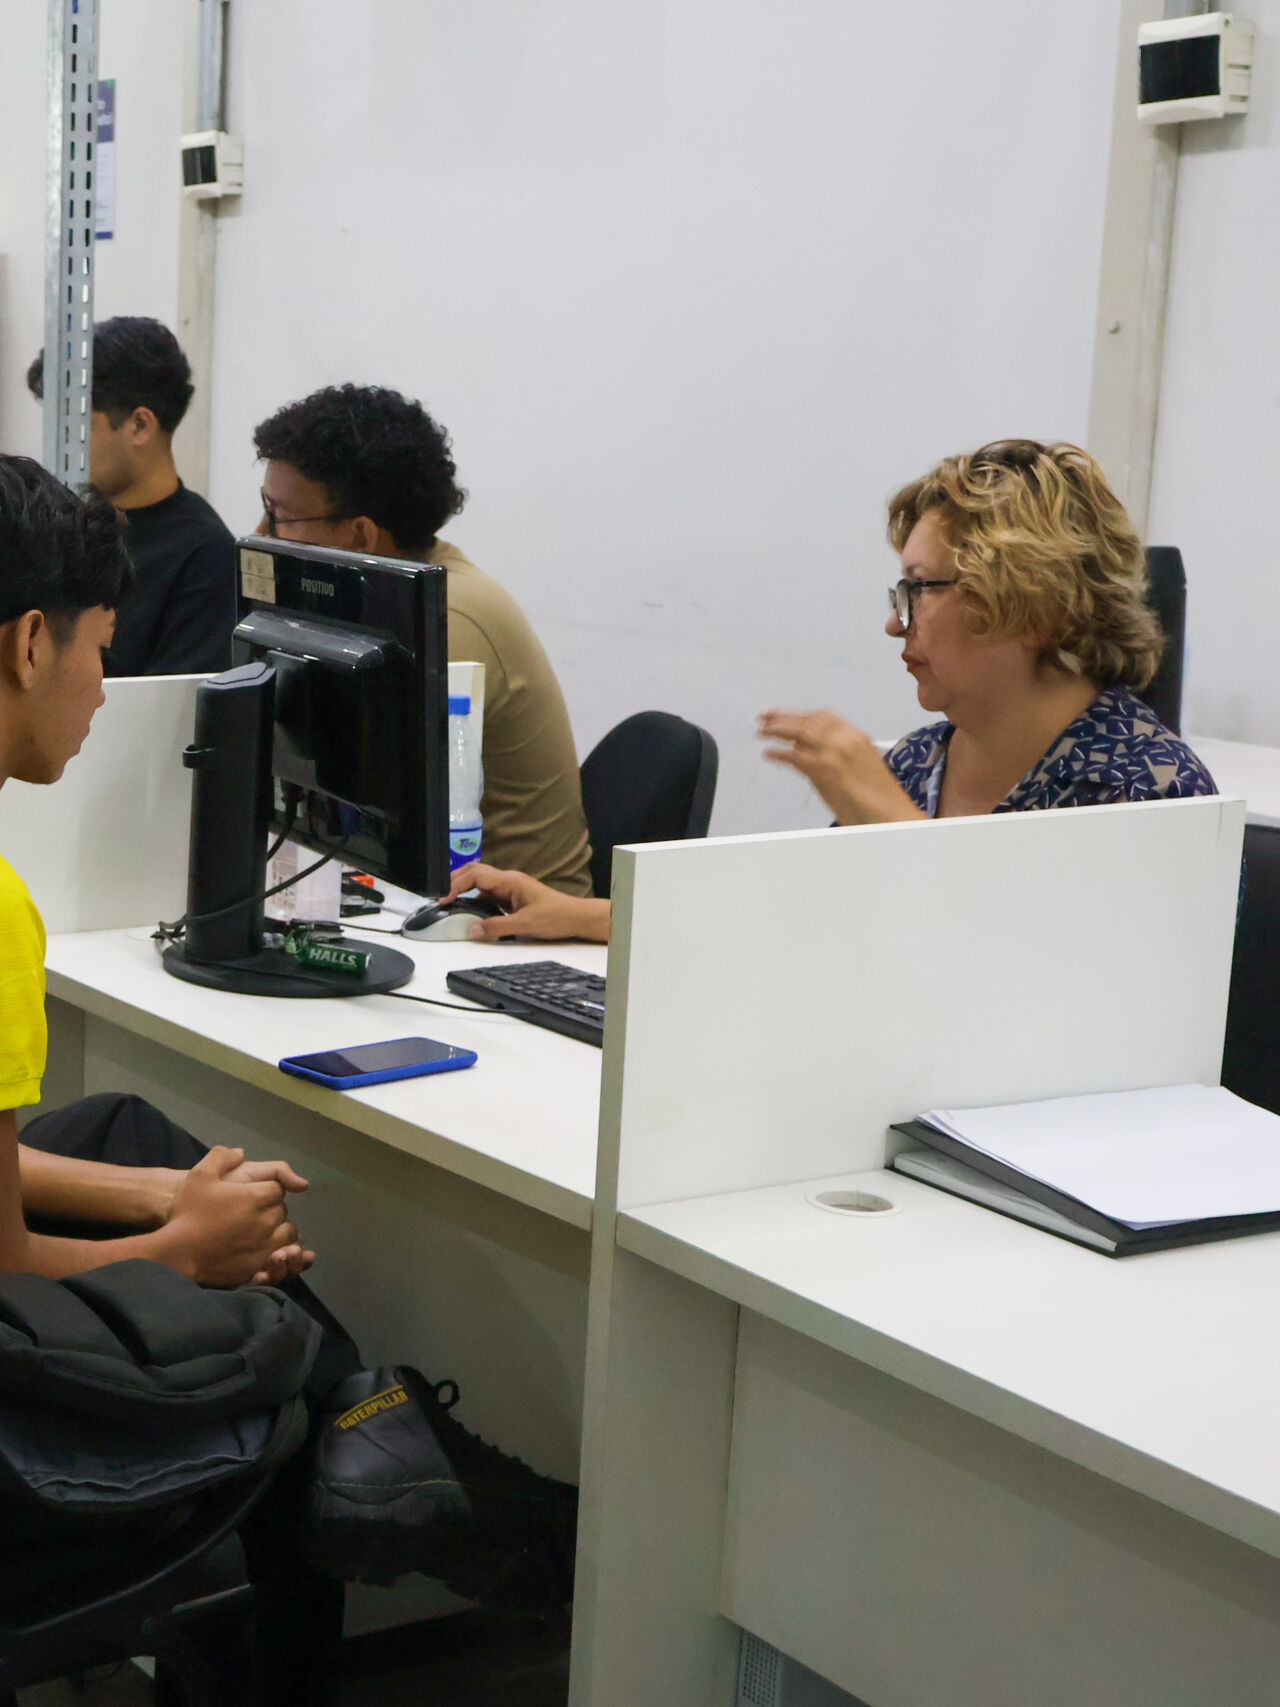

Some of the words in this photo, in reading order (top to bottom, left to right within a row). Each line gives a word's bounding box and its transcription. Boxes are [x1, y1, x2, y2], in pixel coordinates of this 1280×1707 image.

[301, 577, 335, 597] POSITIVO
[308, 948, 357, 966] HALLS
[340, 1390, 409, 1430] CATERPILLAR
